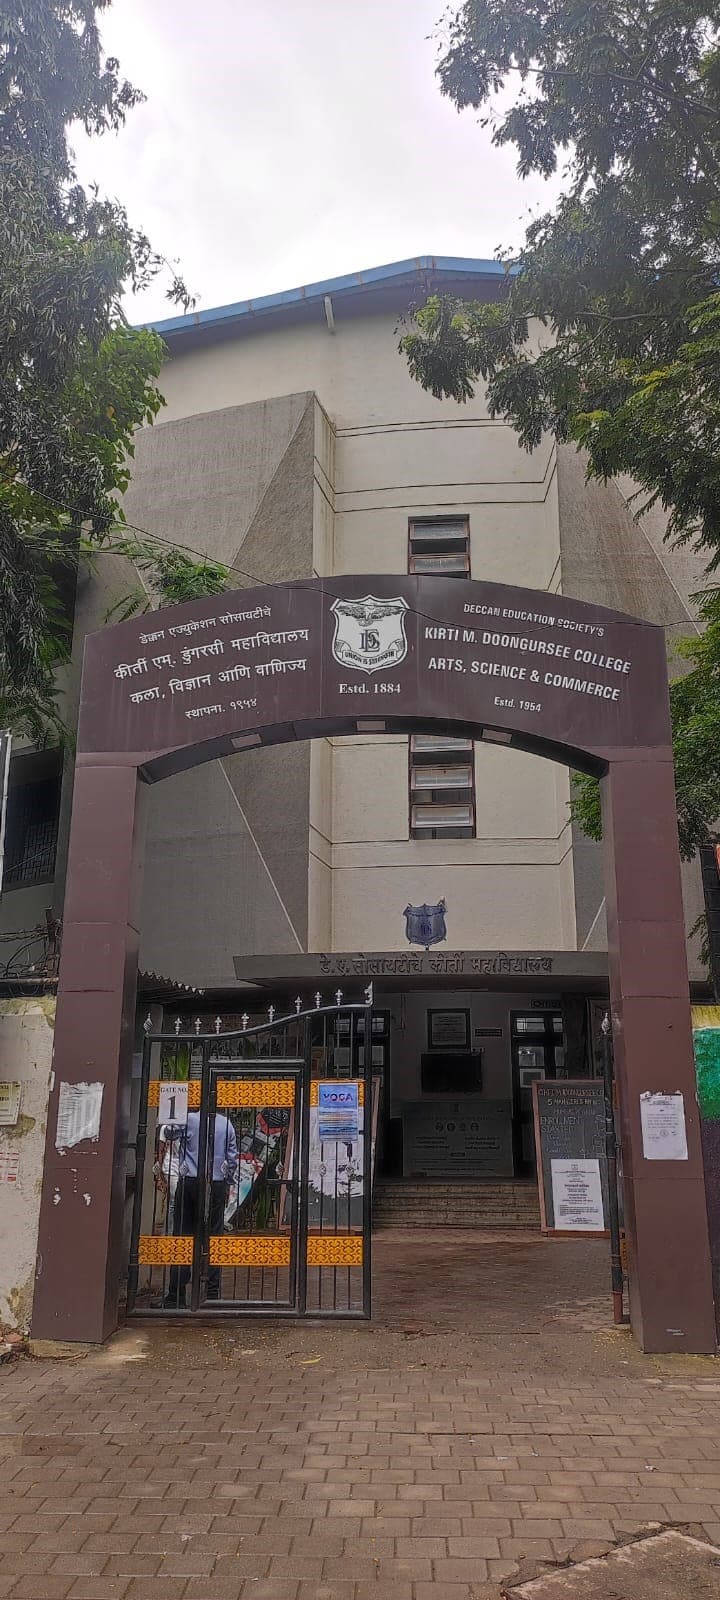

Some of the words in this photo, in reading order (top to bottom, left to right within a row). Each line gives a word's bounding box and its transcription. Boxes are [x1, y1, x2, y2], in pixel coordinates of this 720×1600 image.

[139, 630, 165, 645] डेक्कन
[169, 618, 217, 637] एज्युकेशन
[220, 605, 272, 625] सोसायटीचे
[463, 603, 501, 617] DECCAN
[503, 609, 555, 627] EDUCATION
[558, 618, 605, 637] SOCIETY'S
[181, 639, 225, 665] डुंगरसी
[231, 628, 310, 651] महाविद्यालय
[425, 626, 459, 641] KIRTI
[463, 630, 478, 644] M.
[482, 632, 571, 659] DOONGURSEE
[574, 648, 632, 674] COLLEGE
[130, 687, 165, 705] कला,
[169, 672, 211, 695] विज्ञान
[218, 664, 251, 684] आणि
[256, 658, 307, 678] वाणिज्य
[338, 683, 369, 694] Estd.
[374, 683, 401, 694] 1884
[428, 657, 466, 674] ARTS,
[471, 660, 527, 681] SCIENCE
[530, 670, 540, 683] &
[544, 672, 621, 701] COMMERCE
[185, 703, 225, 720] स्थापना.
[229, 697, 257, 711] १९५४
[494, 696, 515, 708] Estd.
[519, 700, 542, 713] 1954
[168, 1095, 177, 1119] 1
[323, 1093, 353, 1102] YOGA
